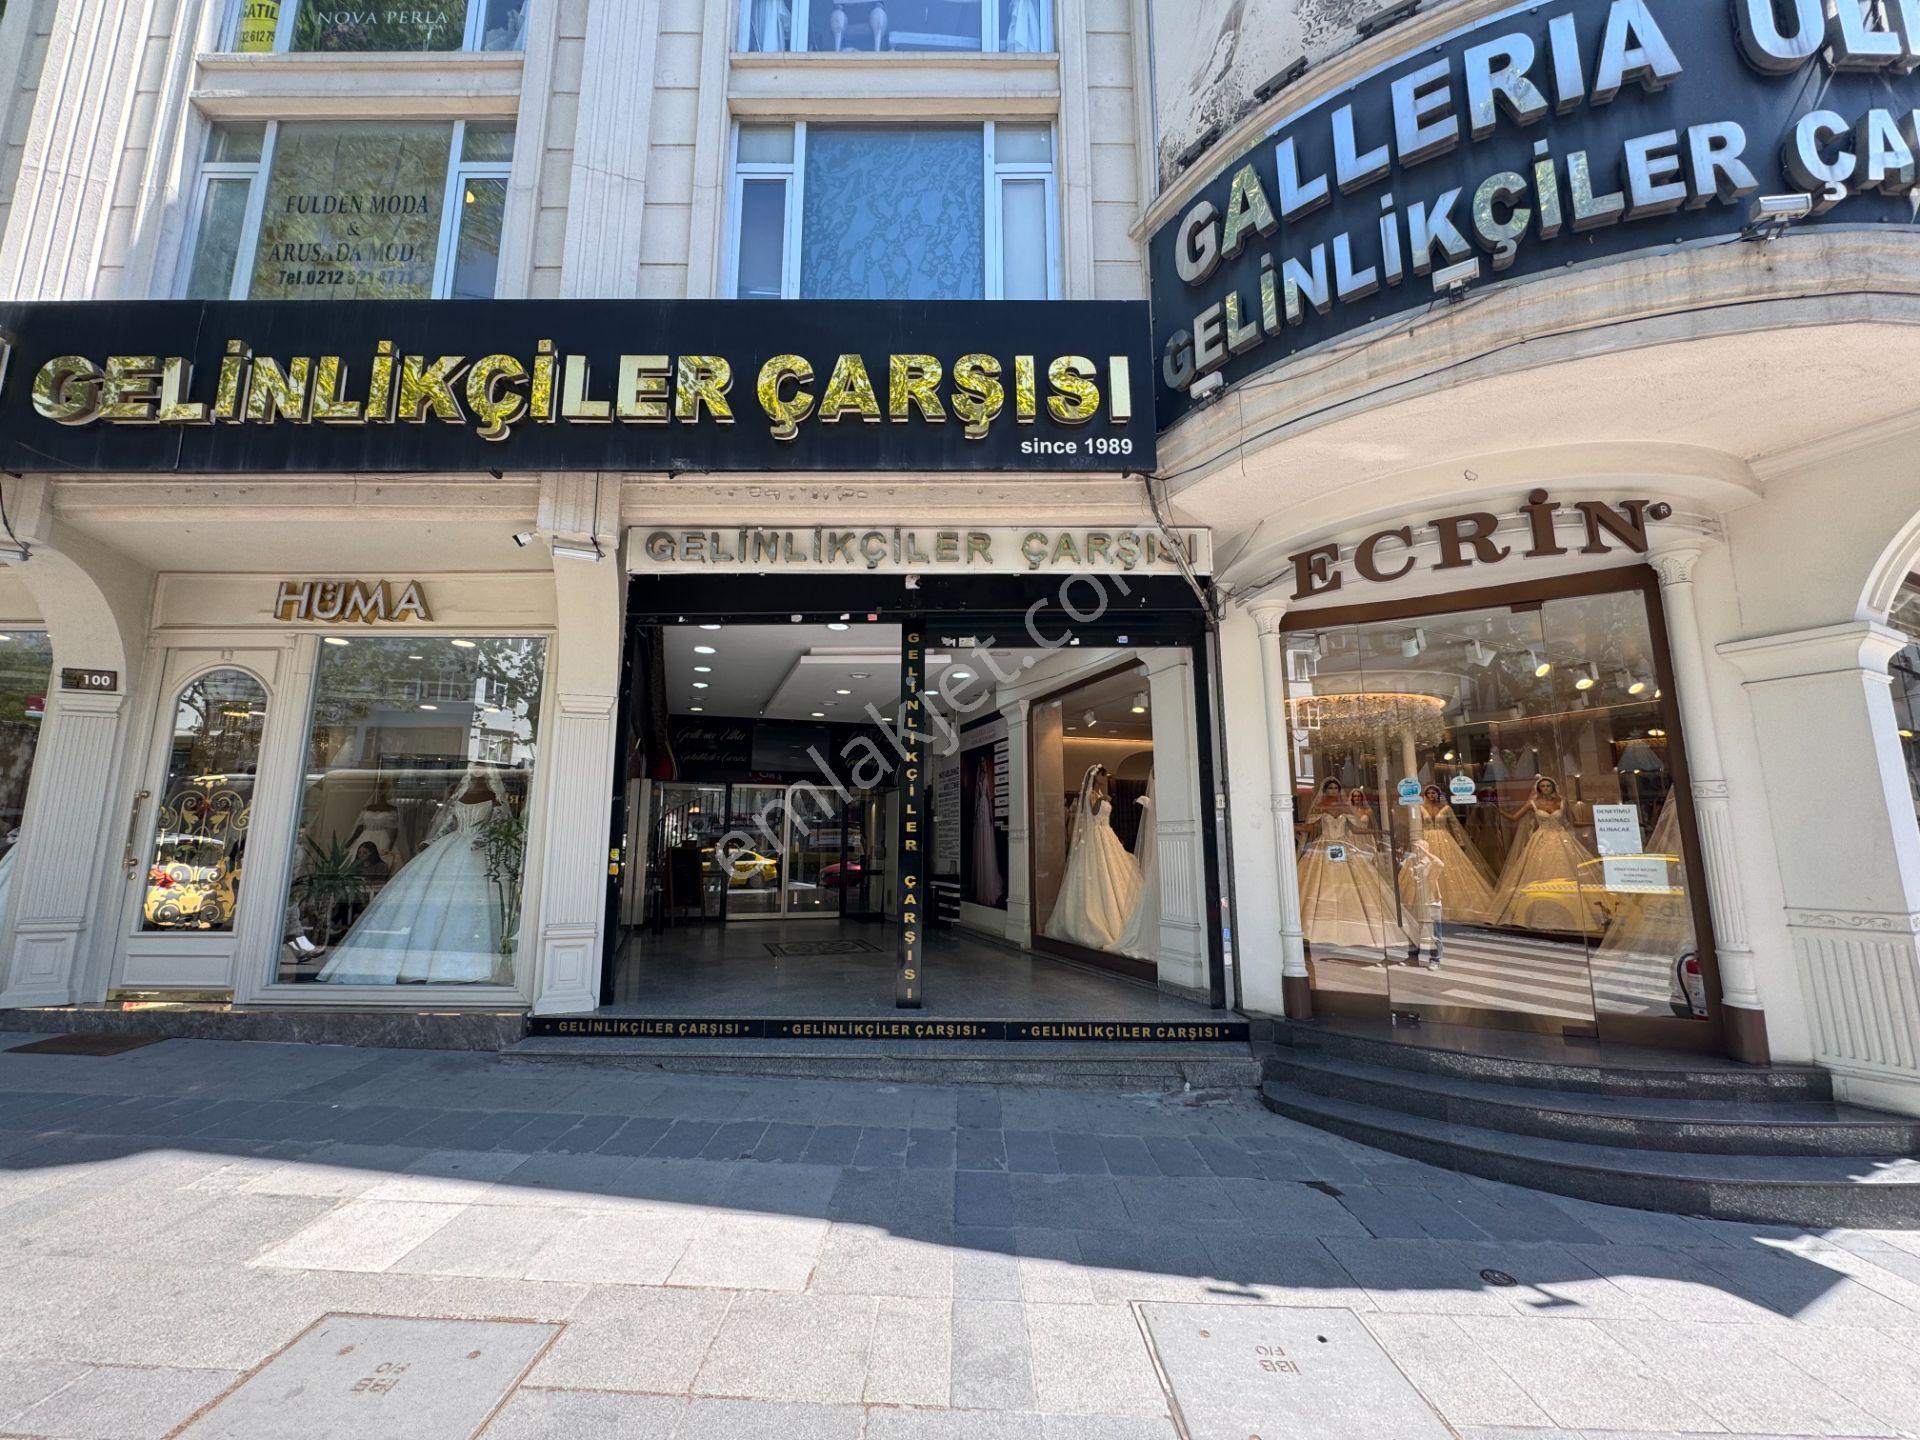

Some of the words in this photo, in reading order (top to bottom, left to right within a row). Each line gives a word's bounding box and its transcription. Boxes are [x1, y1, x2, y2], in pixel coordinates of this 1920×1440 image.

[317, 11, 377, 25] NOVA
[386, 10, 448, 24] PERLA
[1174, 0, 1684, 287] GALLERIA
[286, 195, 363, 214] FULDEN
[369, 195, 429, 214] MODA
[346, 221, 361, 236] &
[1162, 120, 1761, 392] GELİNLİKÇİLER
[1784, 107, 1920, 215] ÇA
[32, 339, 737, 442] GELİNLİKÇİLER
[757, 353, 1132, 441] ÇARŞISI
[1021, 437, 1077, 455] since
[1084, 437, 1133, 455] 1989
[645, 525, 993, 569] GELİNLİKÇİLER
[1288, 488, 1650, 601] ECRİN
[274, 578, 434, 625] HÜMA
[83, 674, 111, 687] 100
[904, 633, 921, 850] GELİNLİKÇİLER
[903, 875, 917, 1000] ÇARŞISI
[558, 1020, 674, 1034] GELİNLİKÇİLER
[678, 1023, 740, 1036] ÇARŞISI
[792, 1022, 910, 1036] GELİNLİKÇİLER
[915, 1023, 977, 1038] ÇARŞISI
[1030, 1023, 1151, 1039] GELİNLİKÇİLER
